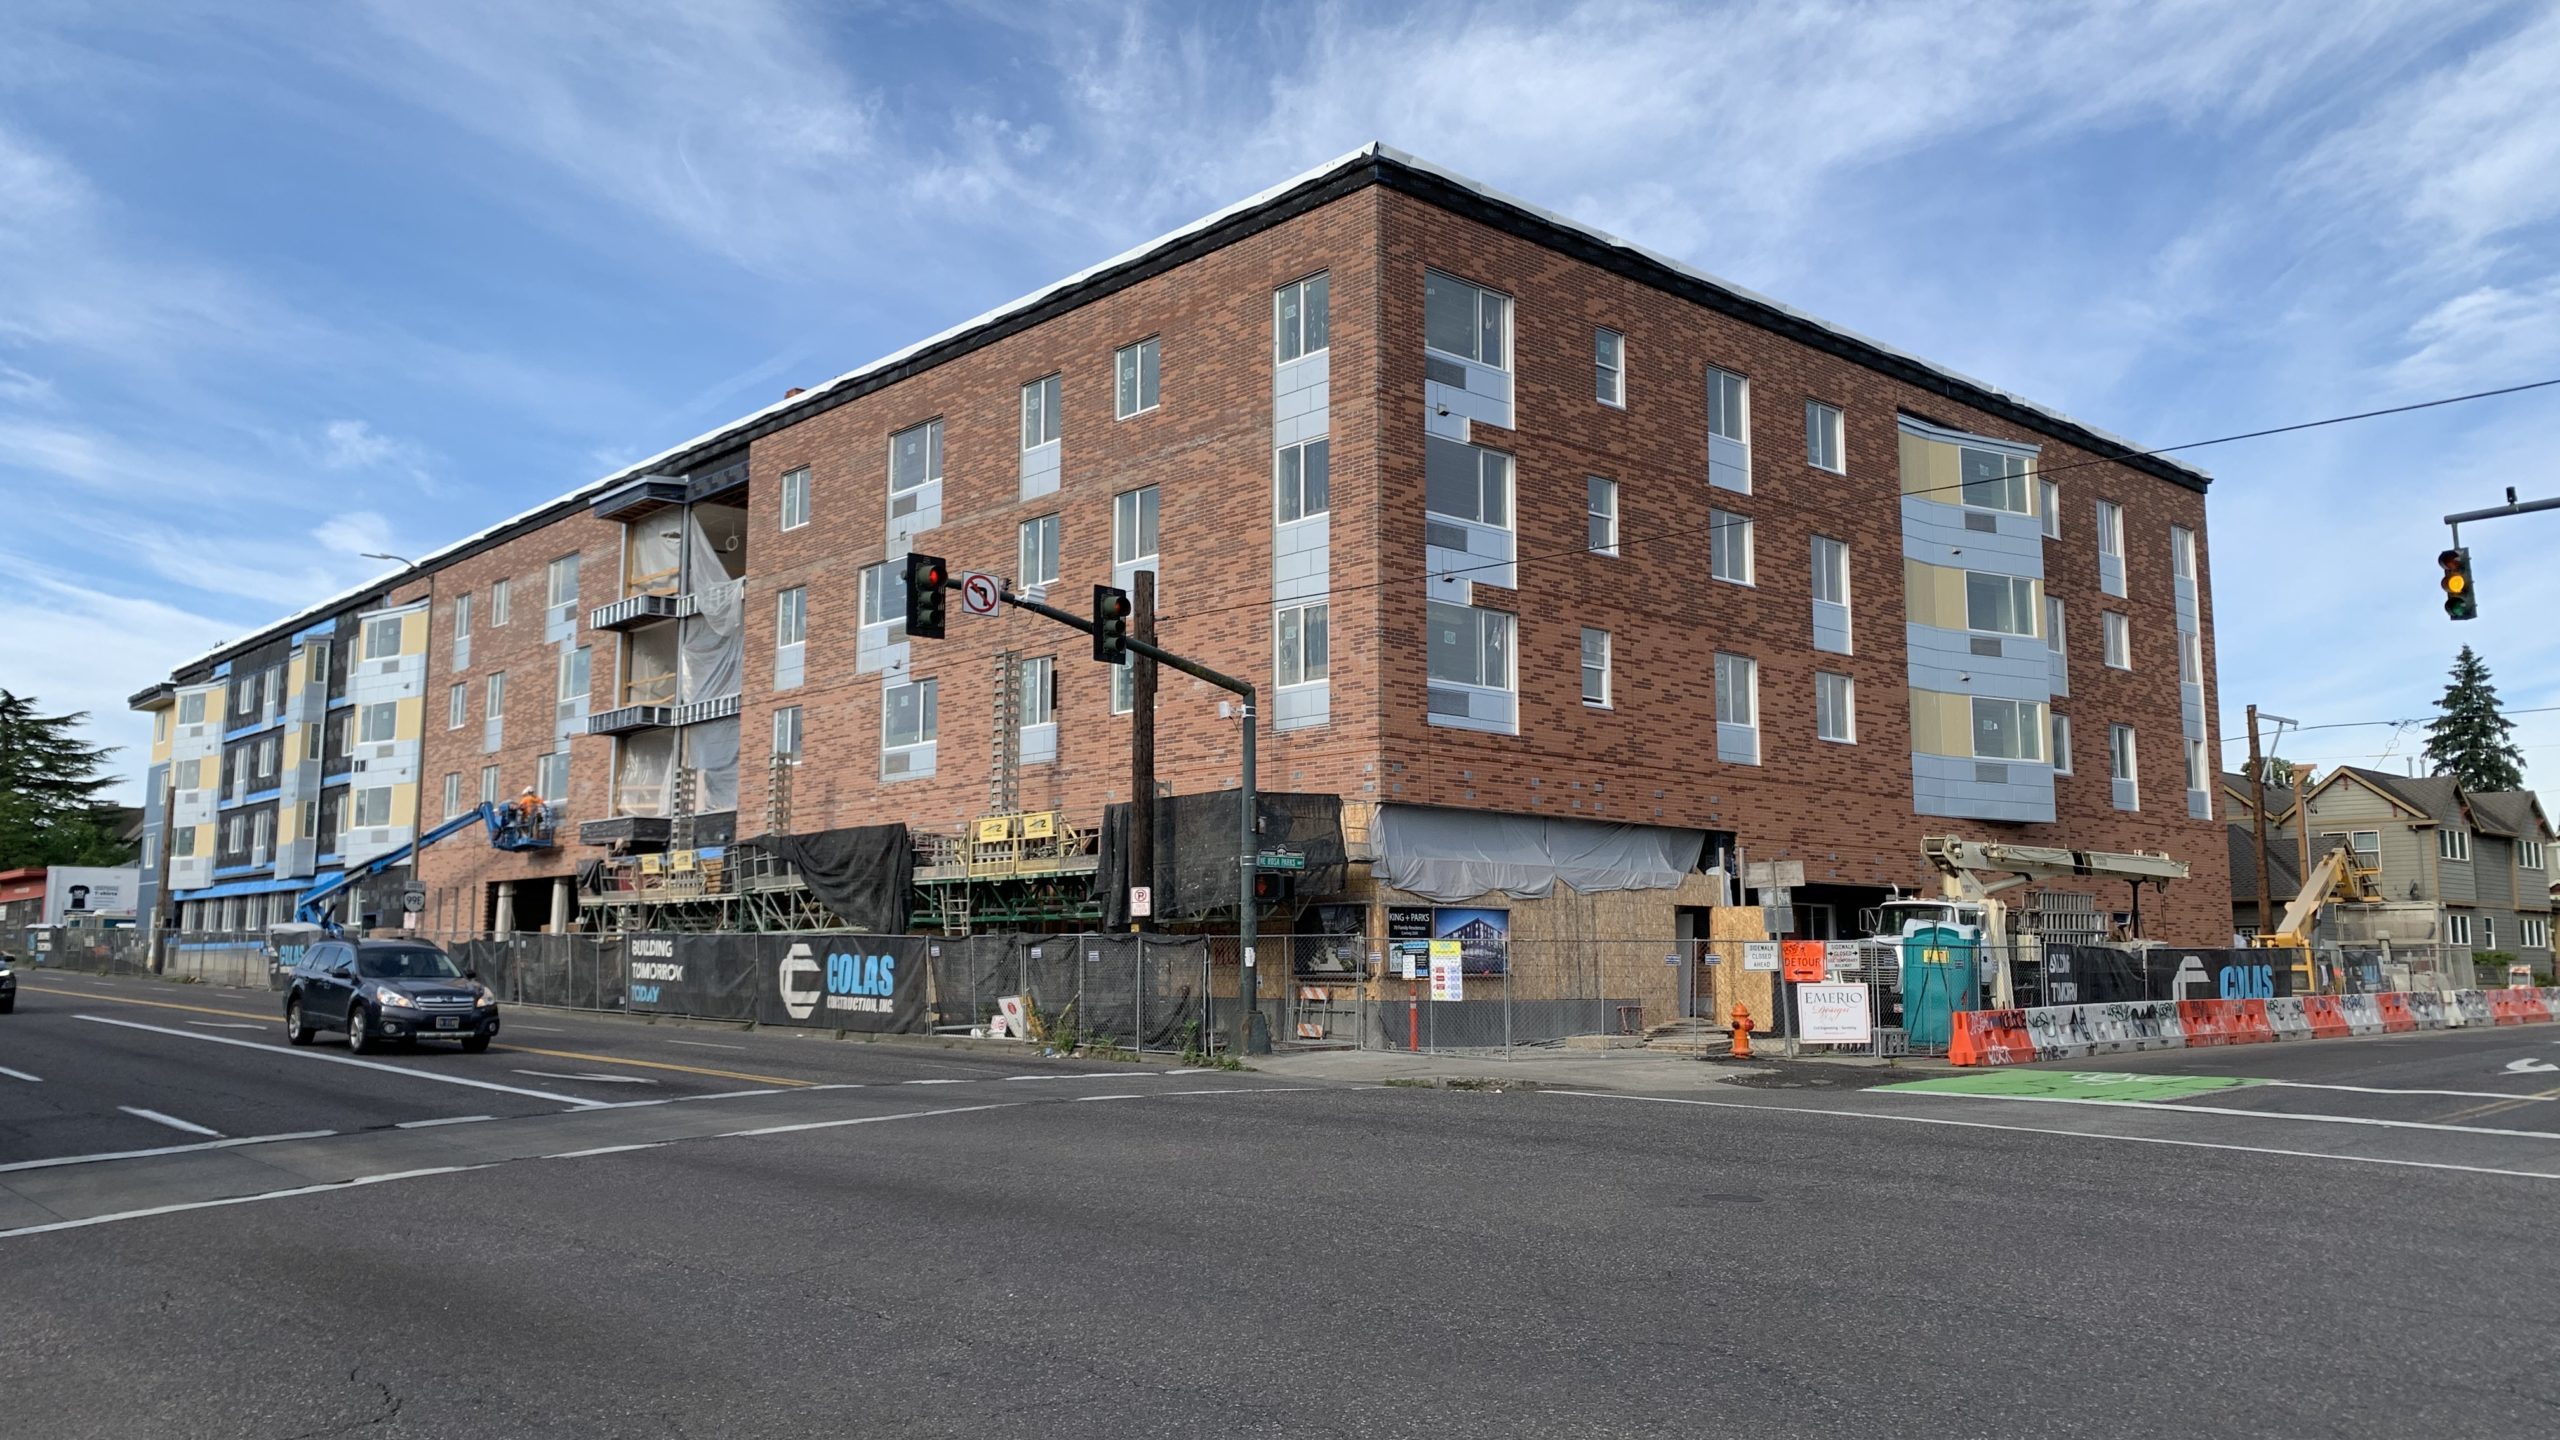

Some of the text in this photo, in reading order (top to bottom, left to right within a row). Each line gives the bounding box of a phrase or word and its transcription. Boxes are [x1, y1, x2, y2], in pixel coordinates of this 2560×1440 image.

[1267, 857, 1280, 866] ROSA
[1281, 858, 1296, 867] PARKS
[406, 895, 422, 906] 99E
[1389, 913, 1405, 922] KING
[1410, 913, 1430, 922] PARKS
[632, 940, 673, 957] BUILDING
[1784, 957, 1822, 968] DETOUR
[827, 953, 895, 997] COLAS
[2219, 964, 2275, 1000] COLAS
[631, 985, 660, 1003] TODAY
[1805, 992, 1863, 1005] EMERIO
[826, 995, 878, 1013] CONSTRUCTION,
